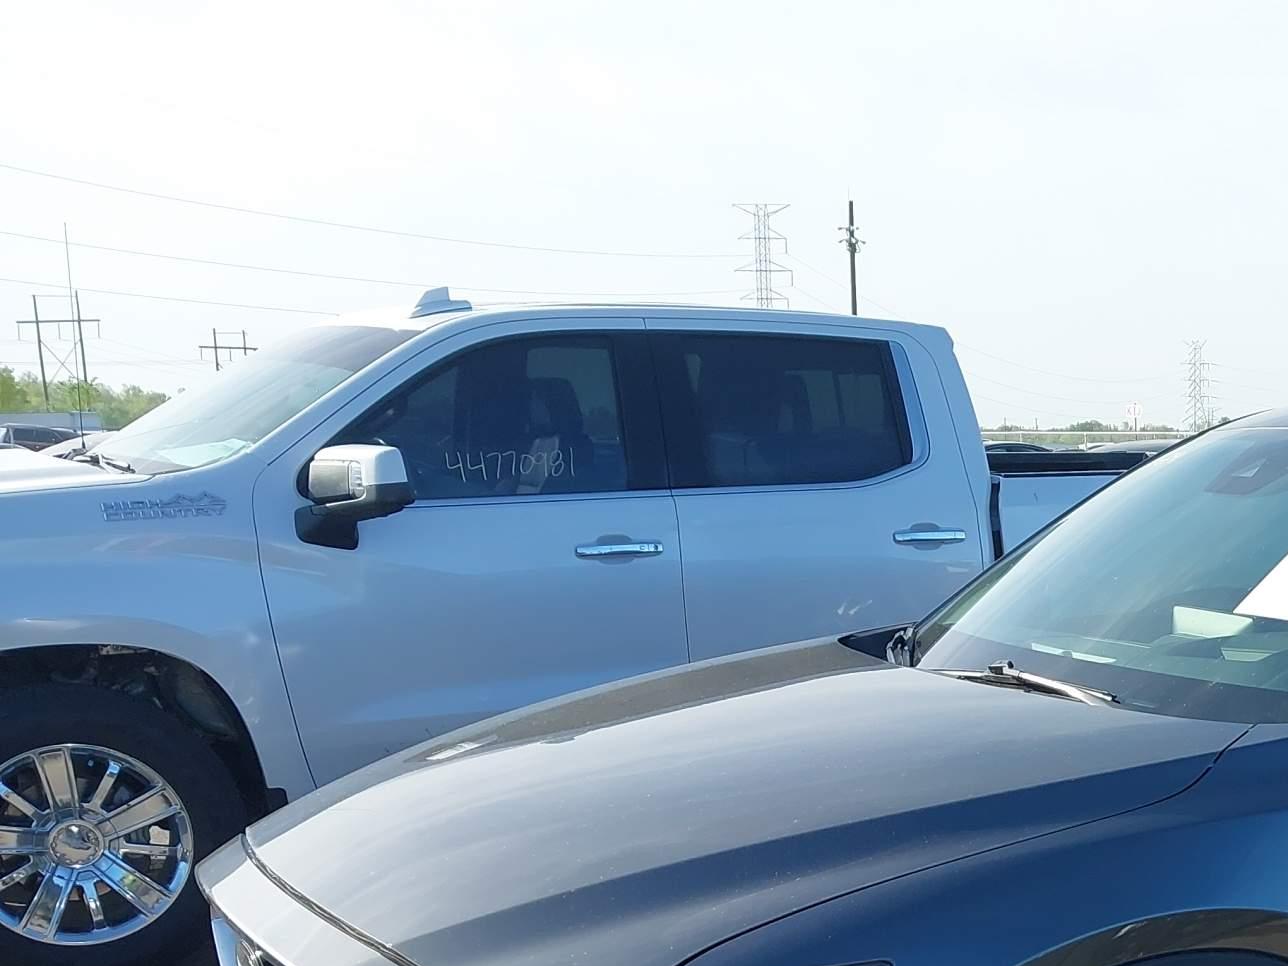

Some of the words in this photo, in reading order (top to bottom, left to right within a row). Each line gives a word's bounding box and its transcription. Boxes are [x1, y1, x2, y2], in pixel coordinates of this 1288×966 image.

[444, 446, 576, 483] 44770981
[100, 498, 162, 512] HIGH
[102, 508, 226, 521] COUNTRY
